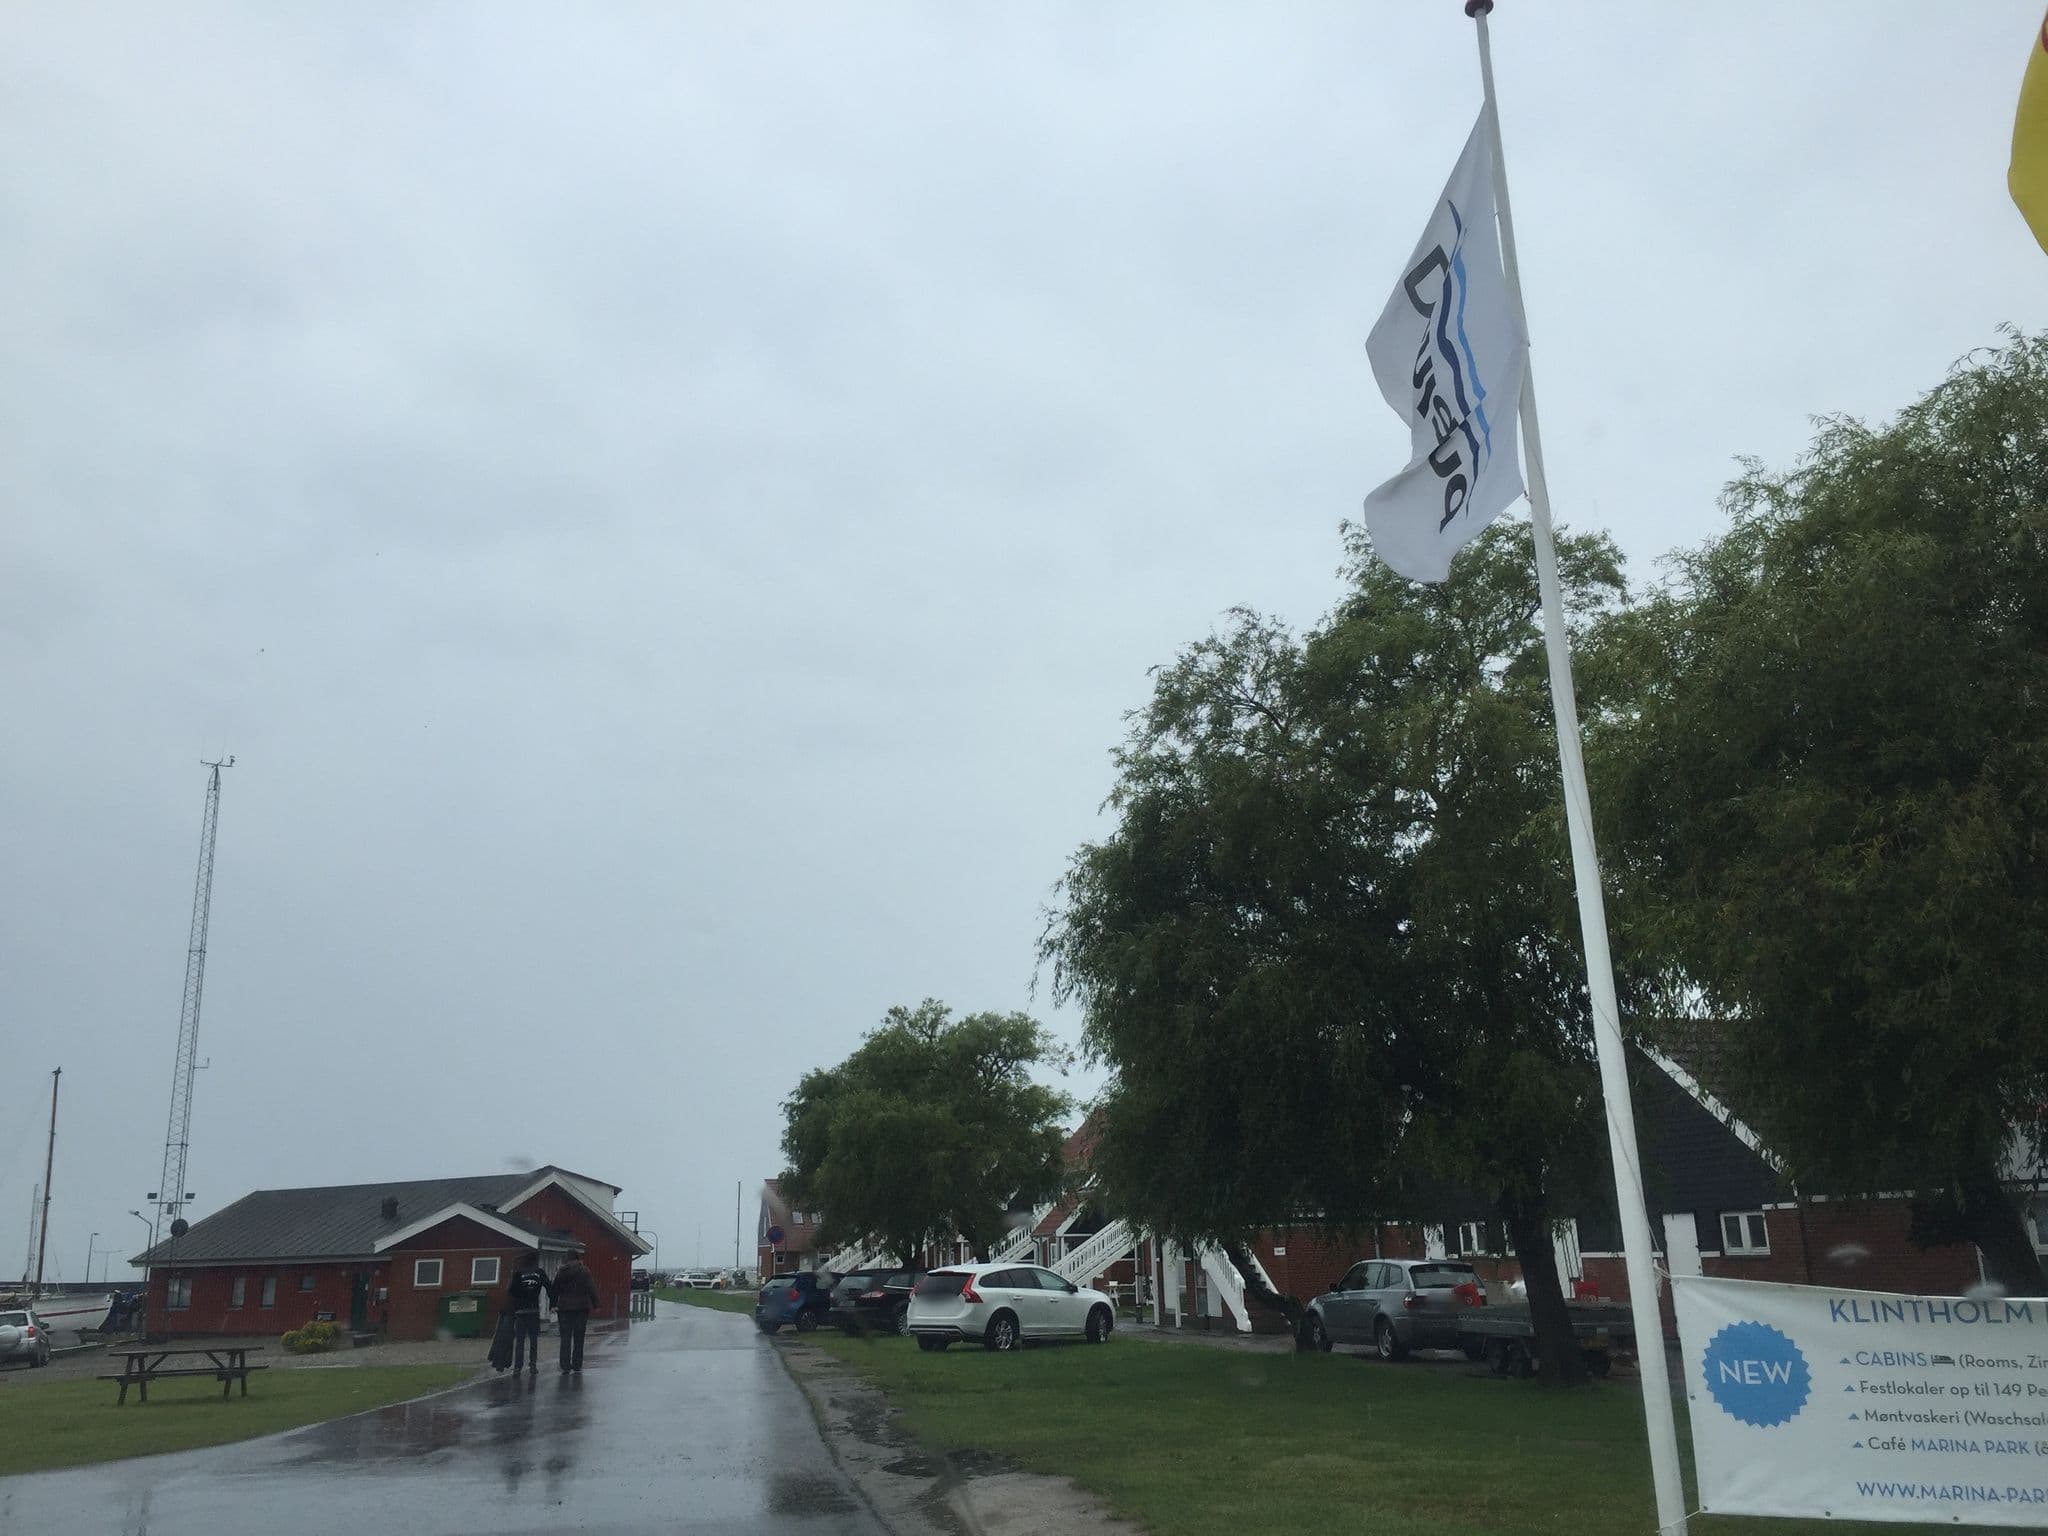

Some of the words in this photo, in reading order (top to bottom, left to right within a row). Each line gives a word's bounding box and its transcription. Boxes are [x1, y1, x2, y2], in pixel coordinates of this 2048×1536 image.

[1829, 1299, 2034, 1324] KLINTHOLM
[1856, 1351, 1928, 1367] CABINS
[1959, 1354, 2024, 1370] (Rooms,
[1719, 1359, 1793, 1385] NEW
[1860, 1380, 1945, 1396] Festlokaler
[1950, 1386, 1970, 1400] op
[1974, 1382, 1990, 1397] til
[1993, 1383, 2022, 1397] 149
[1864, 1409, 1960, 1425] Møntvaskeri
[1963, 1410, 2048, 1427] (Waschsal
[1868, 1436, 1906, 1451] Café
[1911, 1438, 1981, 1454] MARINA
[1984, 1440, 2031, 1456] PARK
[1856, 1481, 2048, 1504] WWW.MARINA-PAR
